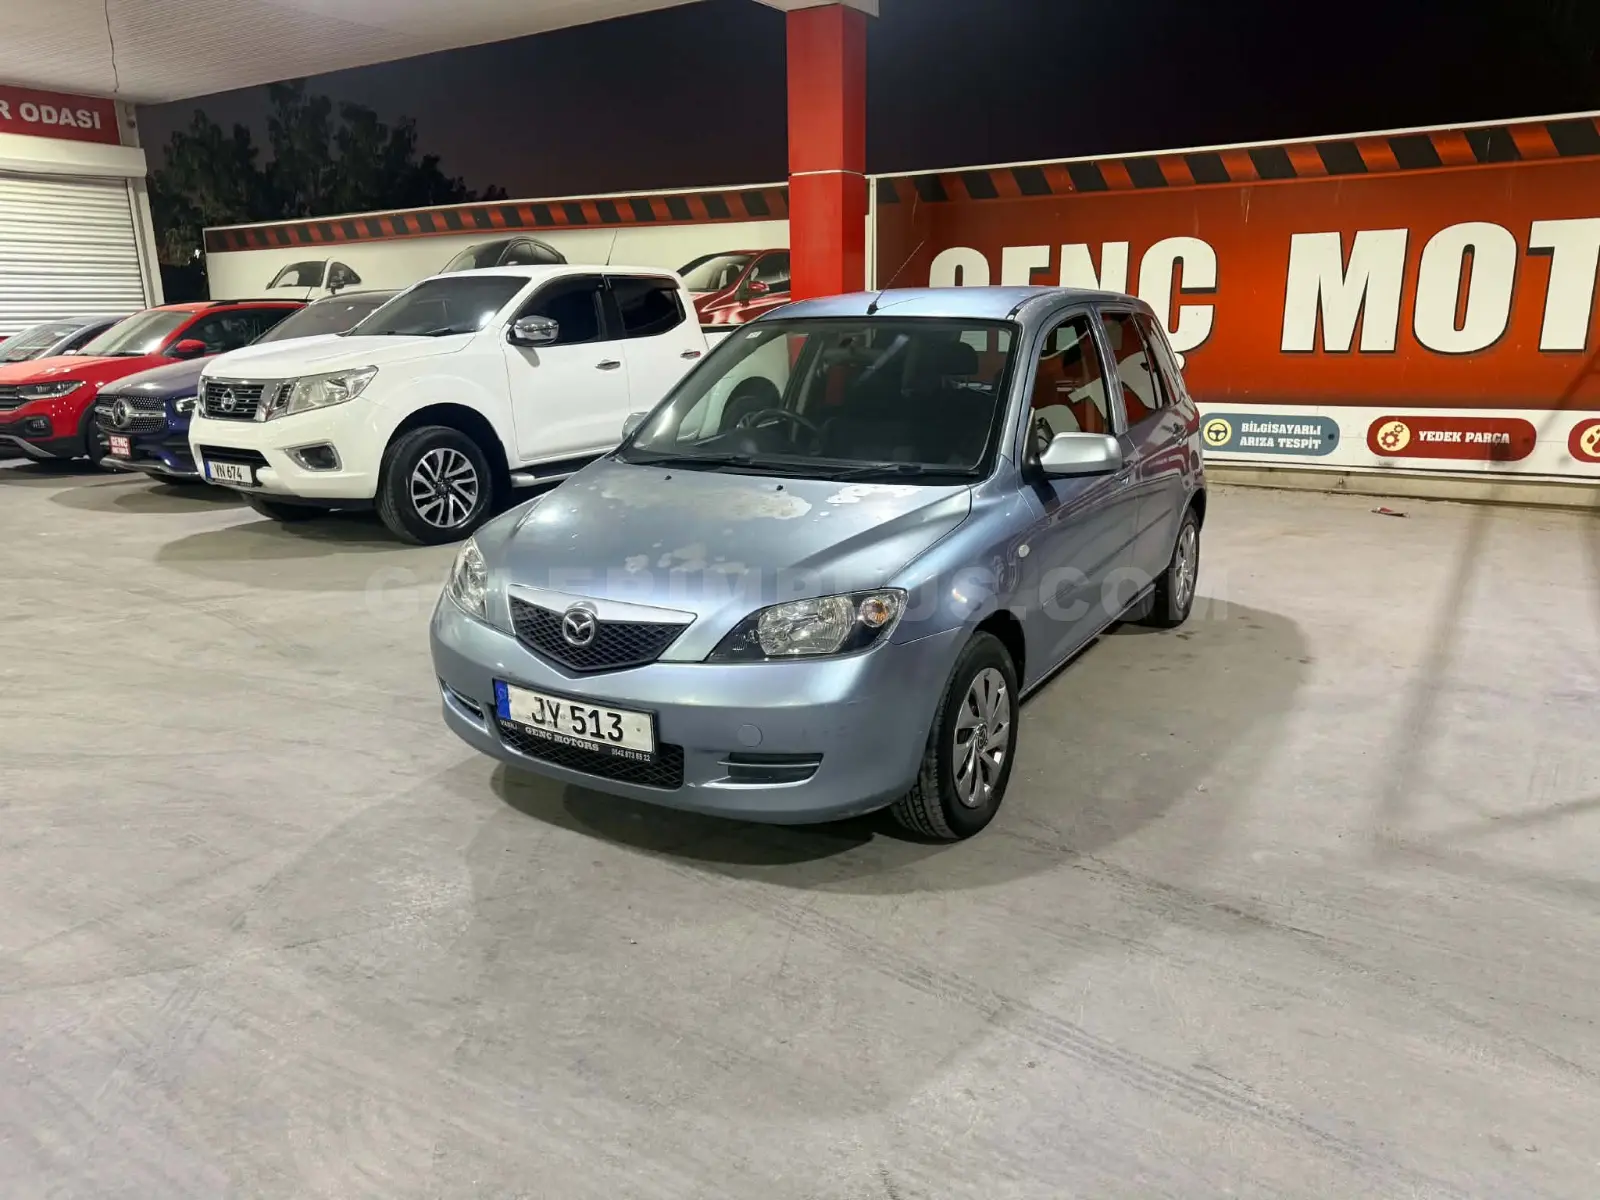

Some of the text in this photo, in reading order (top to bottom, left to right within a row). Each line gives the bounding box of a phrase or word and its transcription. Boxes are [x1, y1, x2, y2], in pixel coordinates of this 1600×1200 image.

[19, 102, 101, 129] ODASI
[1241, 420, 1322, 436] BİLGİSAYARLI
[1240, 436, 1322, 450] ARIZA TESPİT
[1418, 430, 1510, 446] YEDEK PARÇA
[226, 465, 242, 480] 674
[531, 696, 624, 742] JY 513
[553, 734, 600, 752] MOTORS
